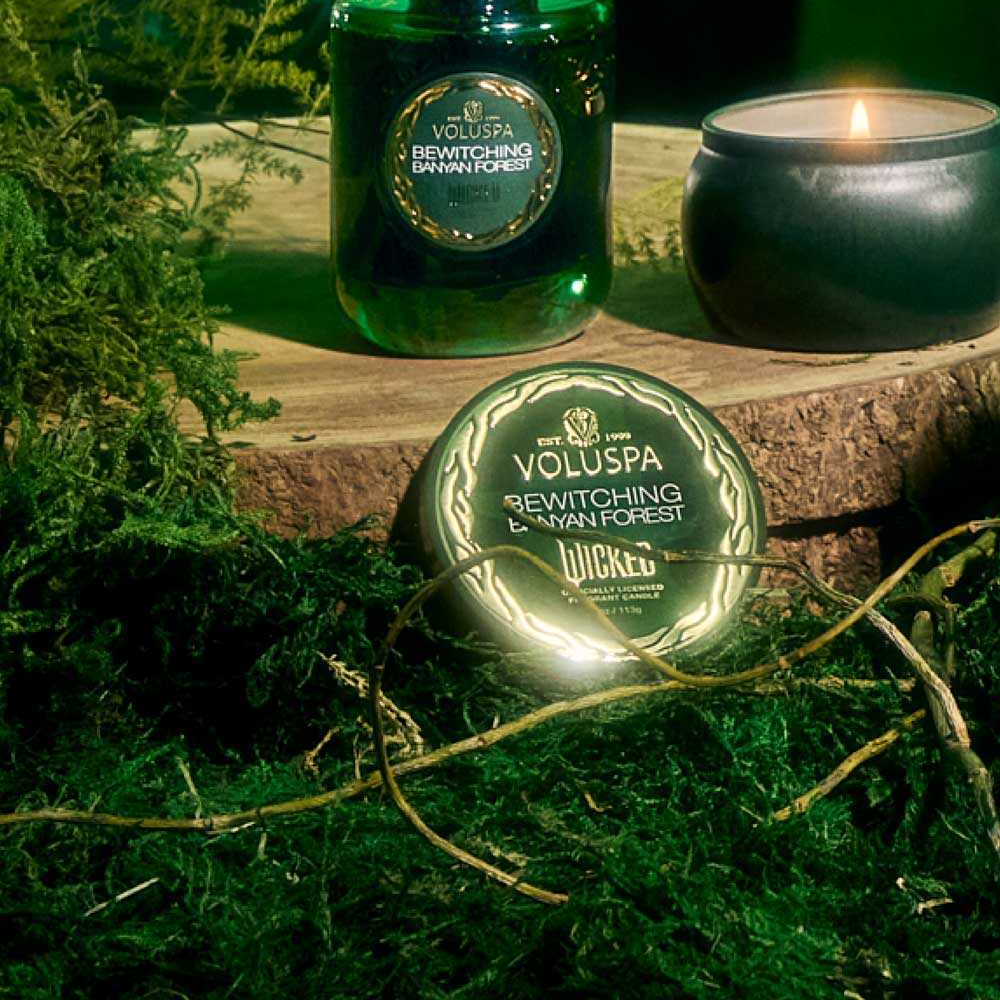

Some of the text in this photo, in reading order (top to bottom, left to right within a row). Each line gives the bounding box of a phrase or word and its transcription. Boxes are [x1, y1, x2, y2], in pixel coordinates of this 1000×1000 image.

[432, 123, 514, 140] VOLUSPA
[412, 143, 533, 160] BEWITCHING
[412, 157, 533, 174] BANYAN FOREST
[513, 444, 663, 481] VOLUSPA
[503, 482, 683, 513] BEWITCHING
[601, 504, 686, 527] FOREST
